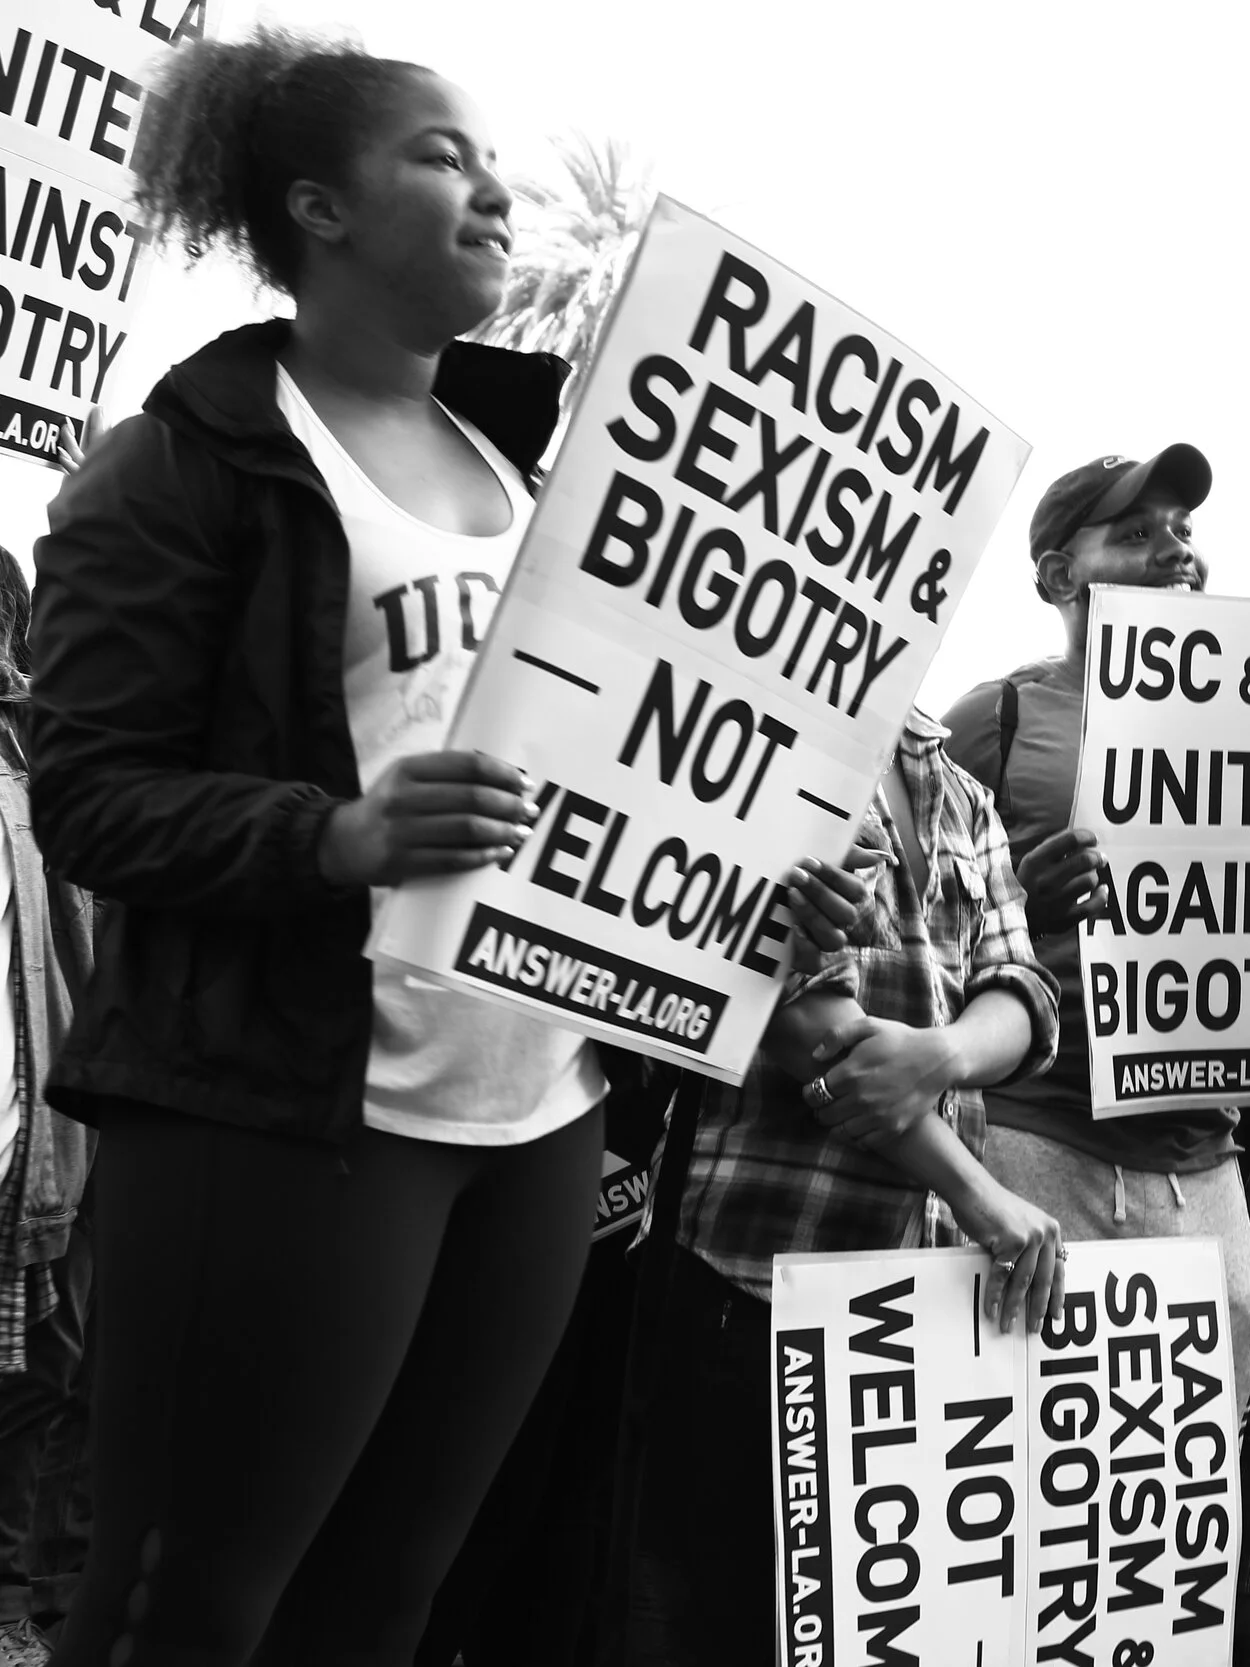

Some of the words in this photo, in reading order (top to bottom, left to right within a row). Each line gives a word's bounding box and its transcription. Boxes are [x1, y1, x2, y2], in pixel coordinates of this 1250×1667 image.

[606, 354, 921, 602] SEXISM
[910, 549, 951, 623] &
[688, 251, 990, 515] RACISM
[579, 470, 909, 718] BIGOTRY
[1100, 625, 1222, 703] USC
[618, 657, 798, 821] NOT
[469, 927, 712, 1041] ANSWER-LA.ORG
[848, 1275, 921, 1667] WELCOM
[944, 1396, 1015, 1599] NOT
[1037, 1291, 1100, 1667] BIGOTRY
[1104, 1270, 1166, 1613] SEXISM
[1167, 1301, 1230, 1636] RACISM
